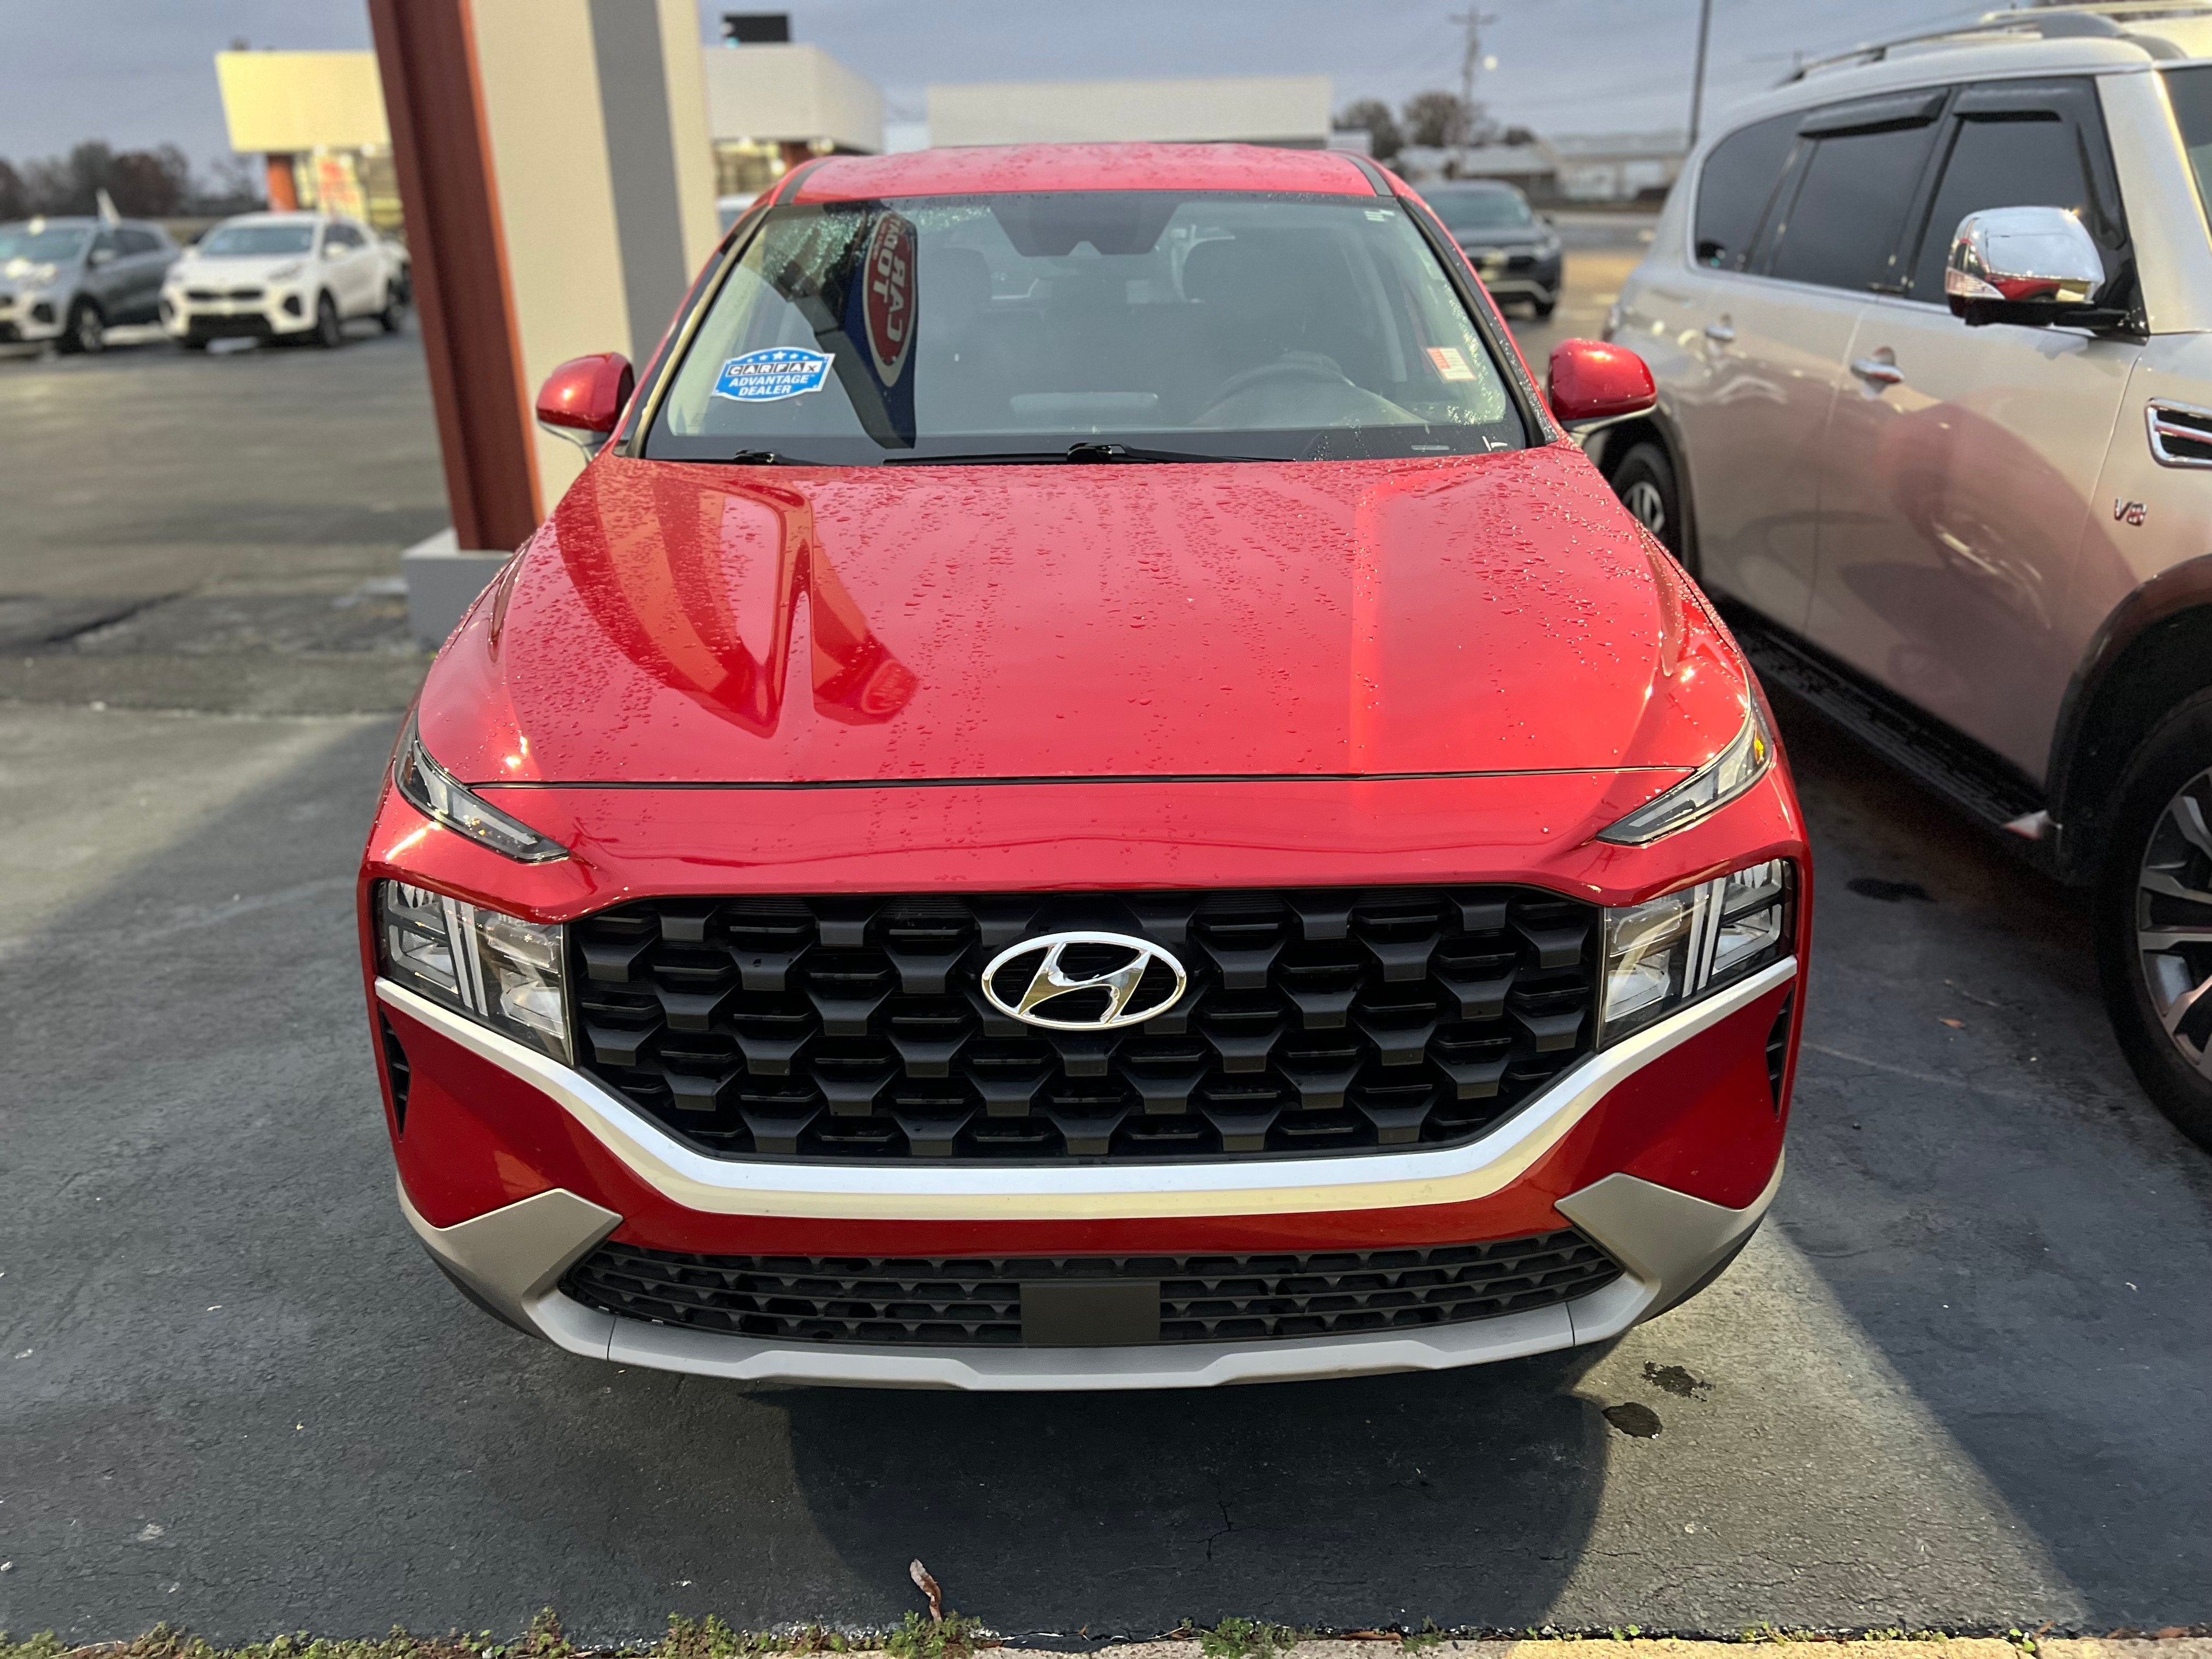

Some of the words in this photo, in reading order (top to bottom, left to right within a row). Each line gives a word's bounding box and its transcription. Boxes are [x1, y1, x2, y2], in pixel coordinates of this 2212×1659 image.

[729, 362, 820, 376] CARFAX
[729, 374, 809, 387] ADVANTAGE
[738, 385, 792, 396] DEALER
[2114, 497, 2147, 527] V8
